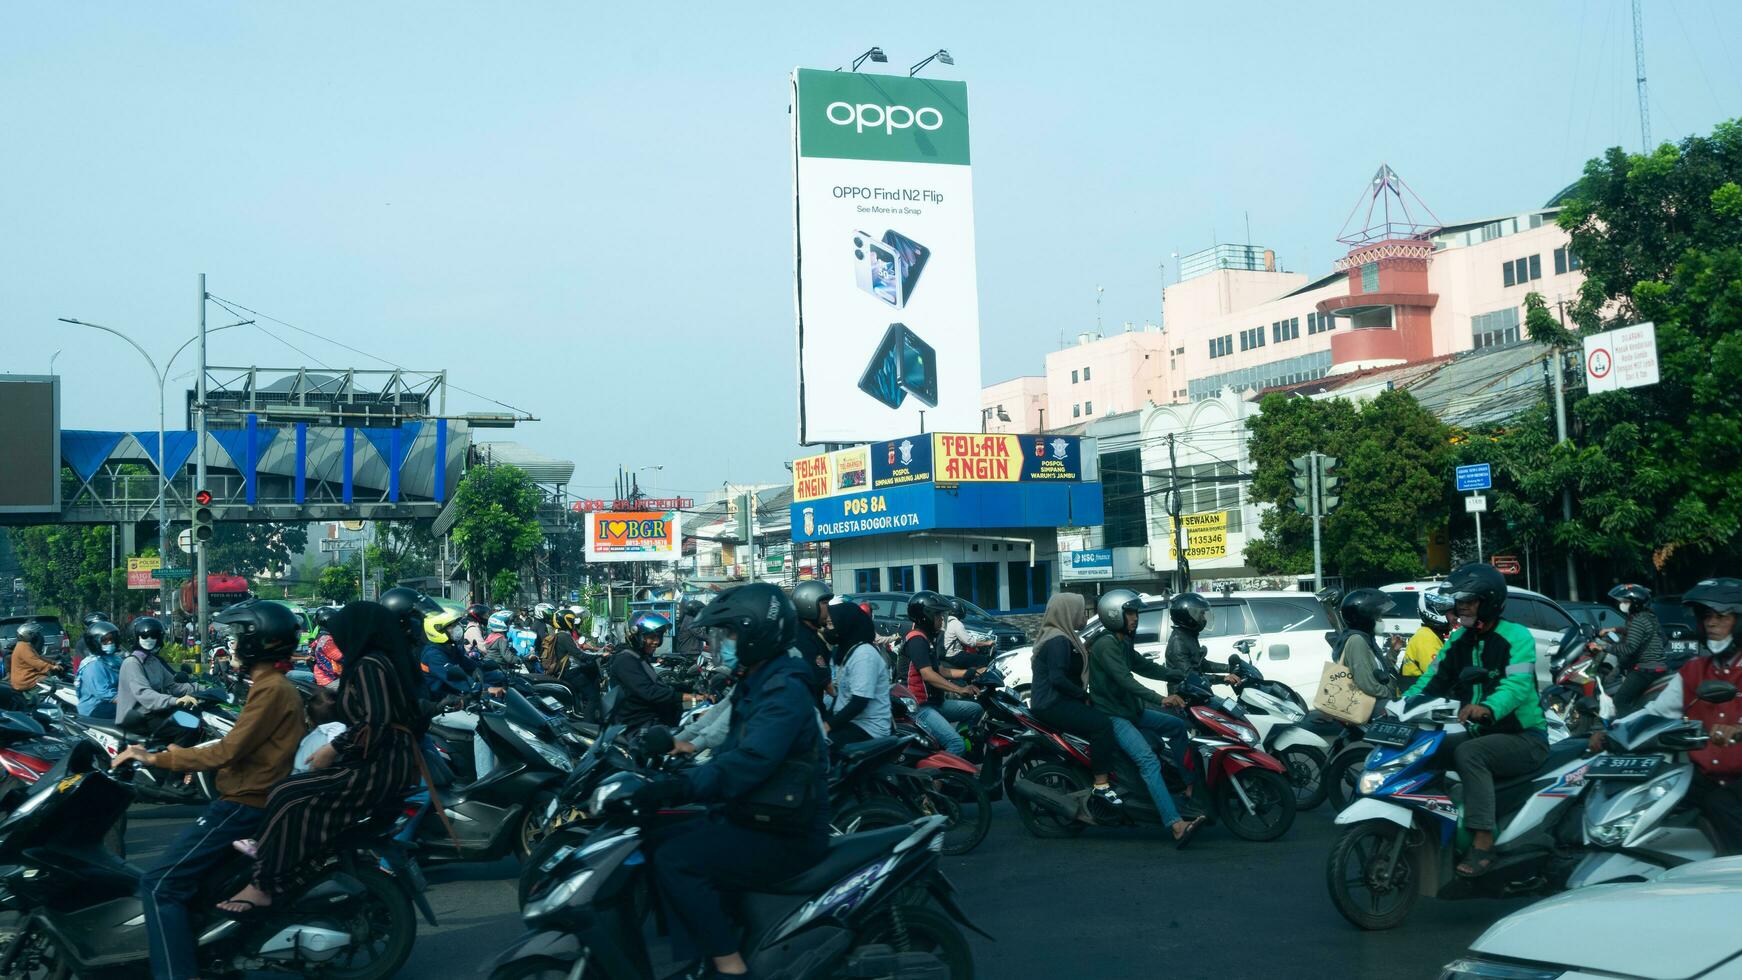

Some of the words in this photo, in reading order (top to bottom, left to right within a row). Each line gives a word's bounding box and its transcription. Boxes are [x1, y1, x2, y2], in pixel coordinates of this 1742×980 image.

[826, 102, 943, 135] oppo
[832, 186, 872, 199] OPPO
[874, 187, 900, 200] Find
[903, 189, 921, 201] N2
[922, 190, 944, 204] Flip
[856, 205, 871, 213] See
[871, 206, 891, 214] More
[891, 206, 898, 214] in
[903, 207, 921, 215] Snap
[942, 436, 1010, 457] TOLAK
[795, 456, 827, 479] TOLAK
[892, 468, 910, 476] POSPOL
[945, 458, 1009, 479] ANGIN
[798, 477, 828, 499] ANGIN
[875, 478, 895, 487] SIMPANG
[895, 475, 913, 484] WARUNG
[913, 472, 930, 481] JAMBU
[844, 498, 868, 516] POS
[870, 495, 887, 512] 8A
[600, 520, 609, 539] I
[627, 520, 667, 539] BGR
[817, 520, 860, 536] POLRESTA
[860, 516, 892, 531] BOGOR
[893, 513, 920, 527] KOTA
[1185, 514, 1220, 526] SEWAKAN
[1081, 553, 1095, 562] NSC
[1172, 546, 1226, 557] 0128997575
